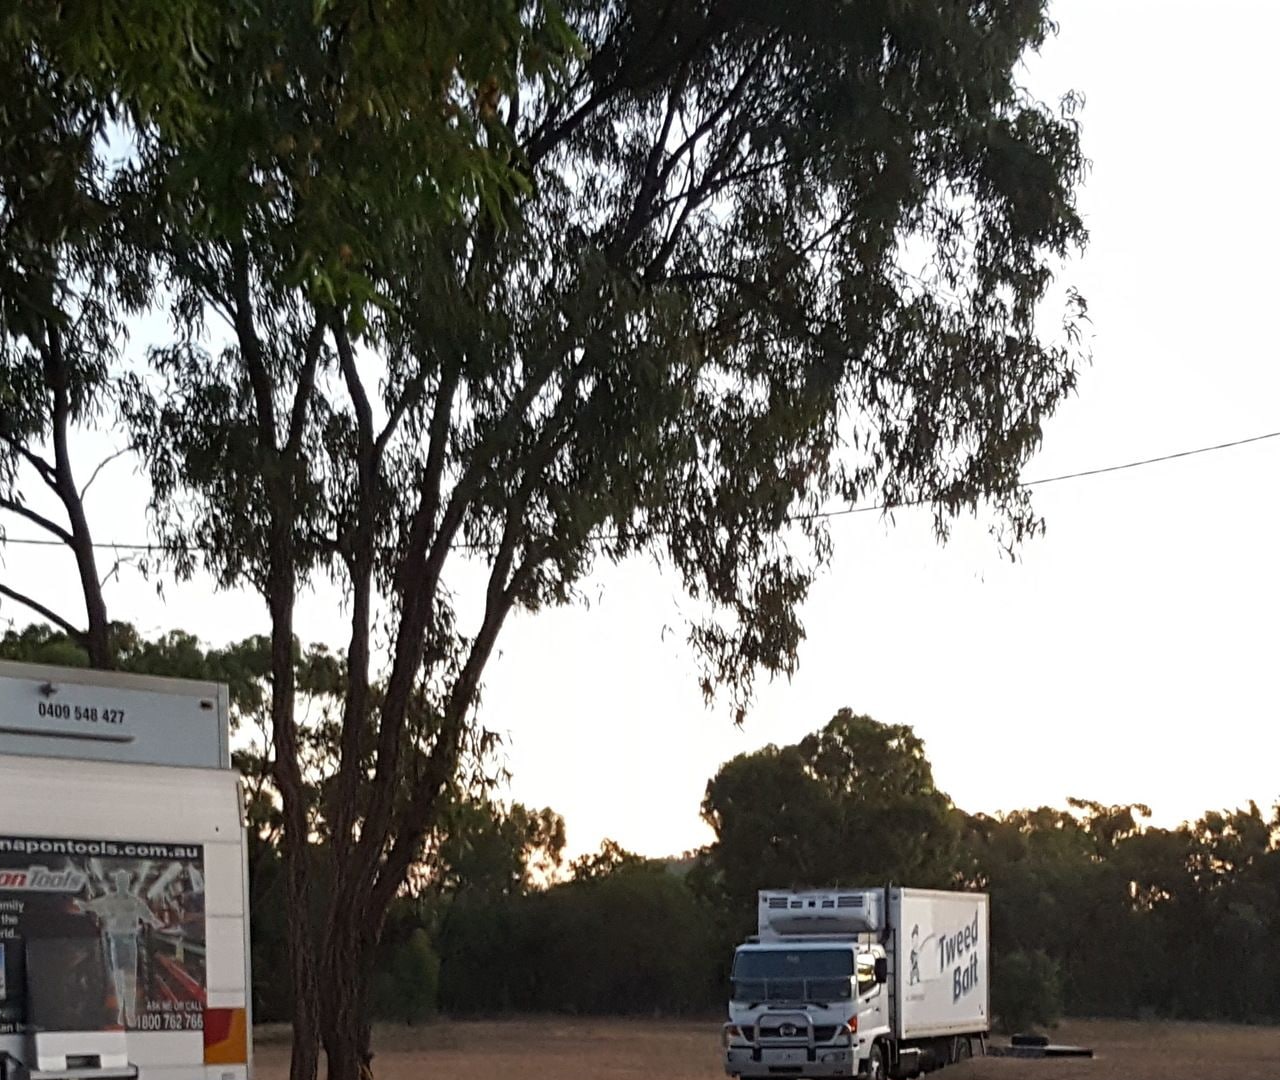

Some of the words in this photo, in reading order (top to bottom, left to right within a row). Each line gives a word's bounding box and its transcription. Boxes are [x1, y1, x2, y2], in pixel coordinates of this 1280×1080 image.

[102, 708, 125, 724] 427
[1, 913, 18, 925] the
[939, 909, 978, 974] Tweed
[953, 951, 978, 1005] Bait
[163, 1012, 182, 1030] 762
